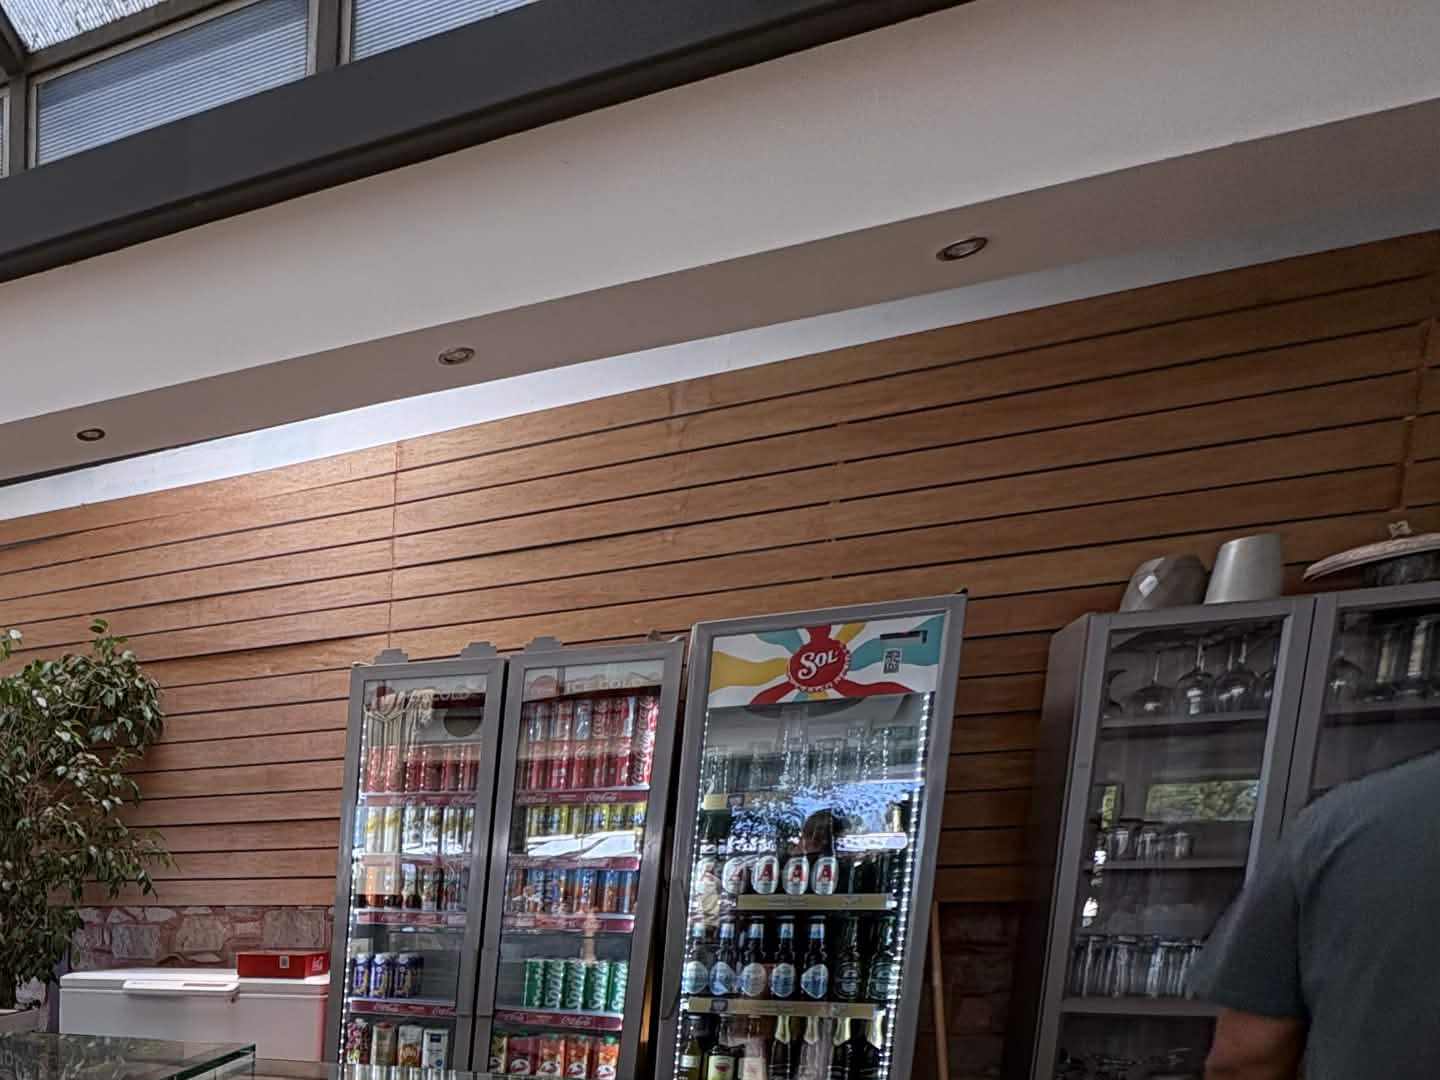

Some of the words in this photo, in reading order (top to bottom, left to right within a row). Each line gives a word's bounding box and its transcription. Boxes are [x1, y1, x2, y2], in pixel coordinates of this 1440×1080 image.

[759, 863, 774, 881] A
[789, 864, 805, 881] A
[816, 864, 833, 881] A
